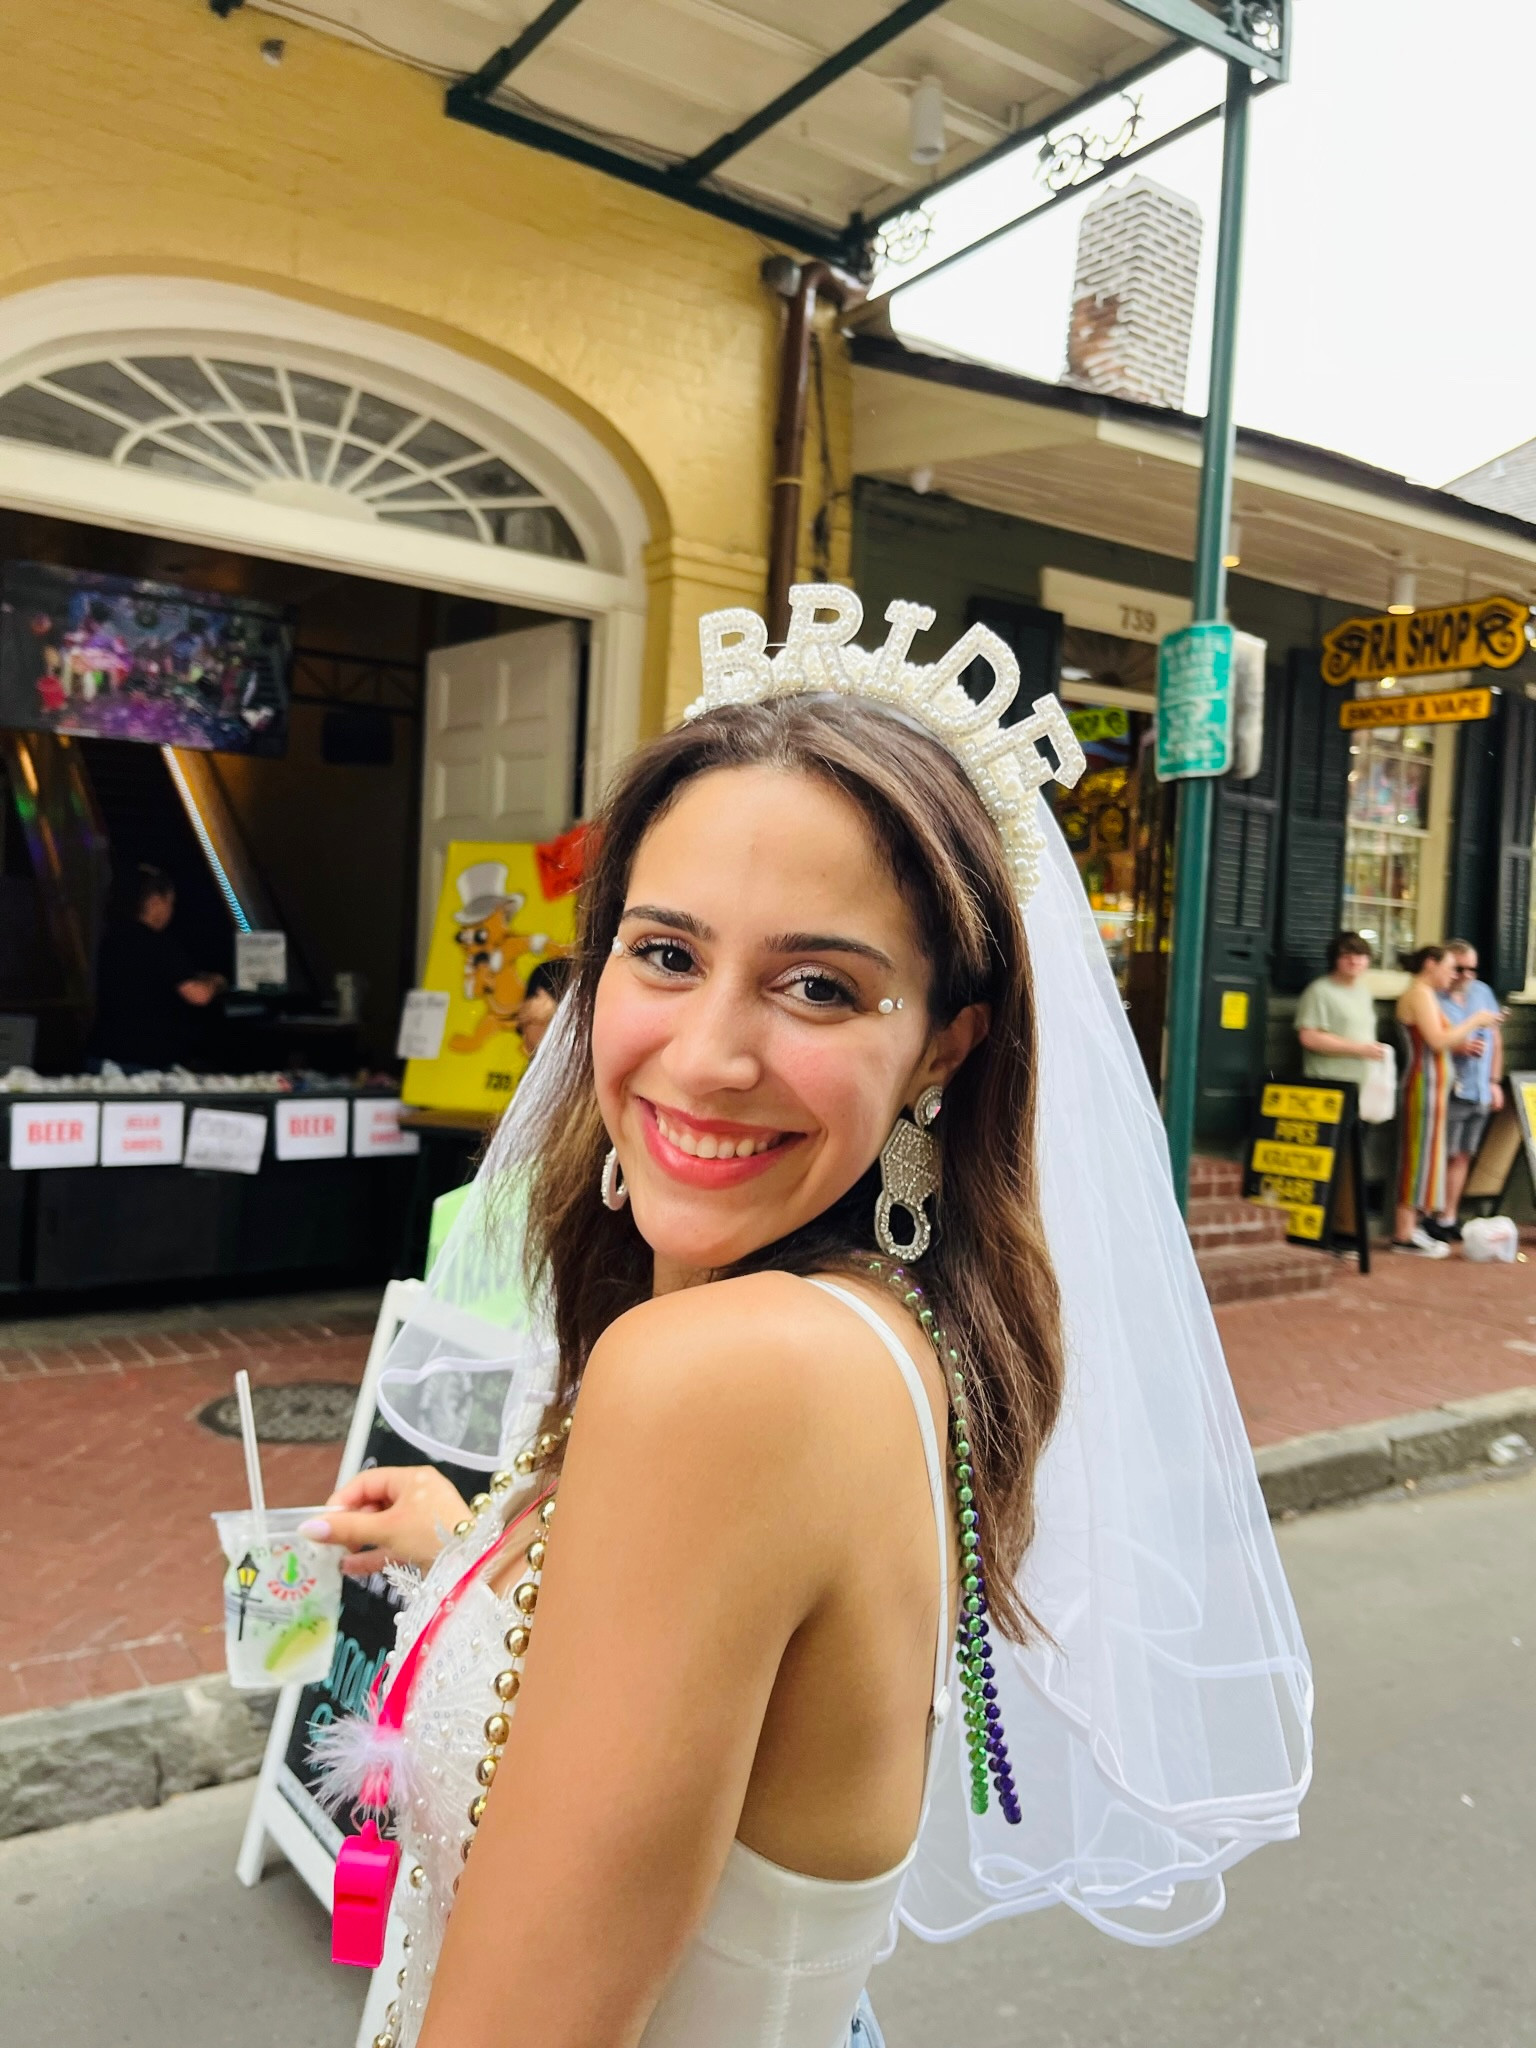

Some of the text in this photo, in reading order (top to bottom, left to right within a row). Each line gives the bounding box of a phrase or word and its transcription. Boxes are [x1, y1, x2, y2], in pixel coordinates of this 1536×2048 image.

[1406, 611, 1471, 667] SHOP
[698, 583, 1087, 793] BRIDE
[1432, 695, 1482, 715] VAPE
[27, 1119, 84, 1145] BEER
[288, 1115, 335, 1137] BEER
